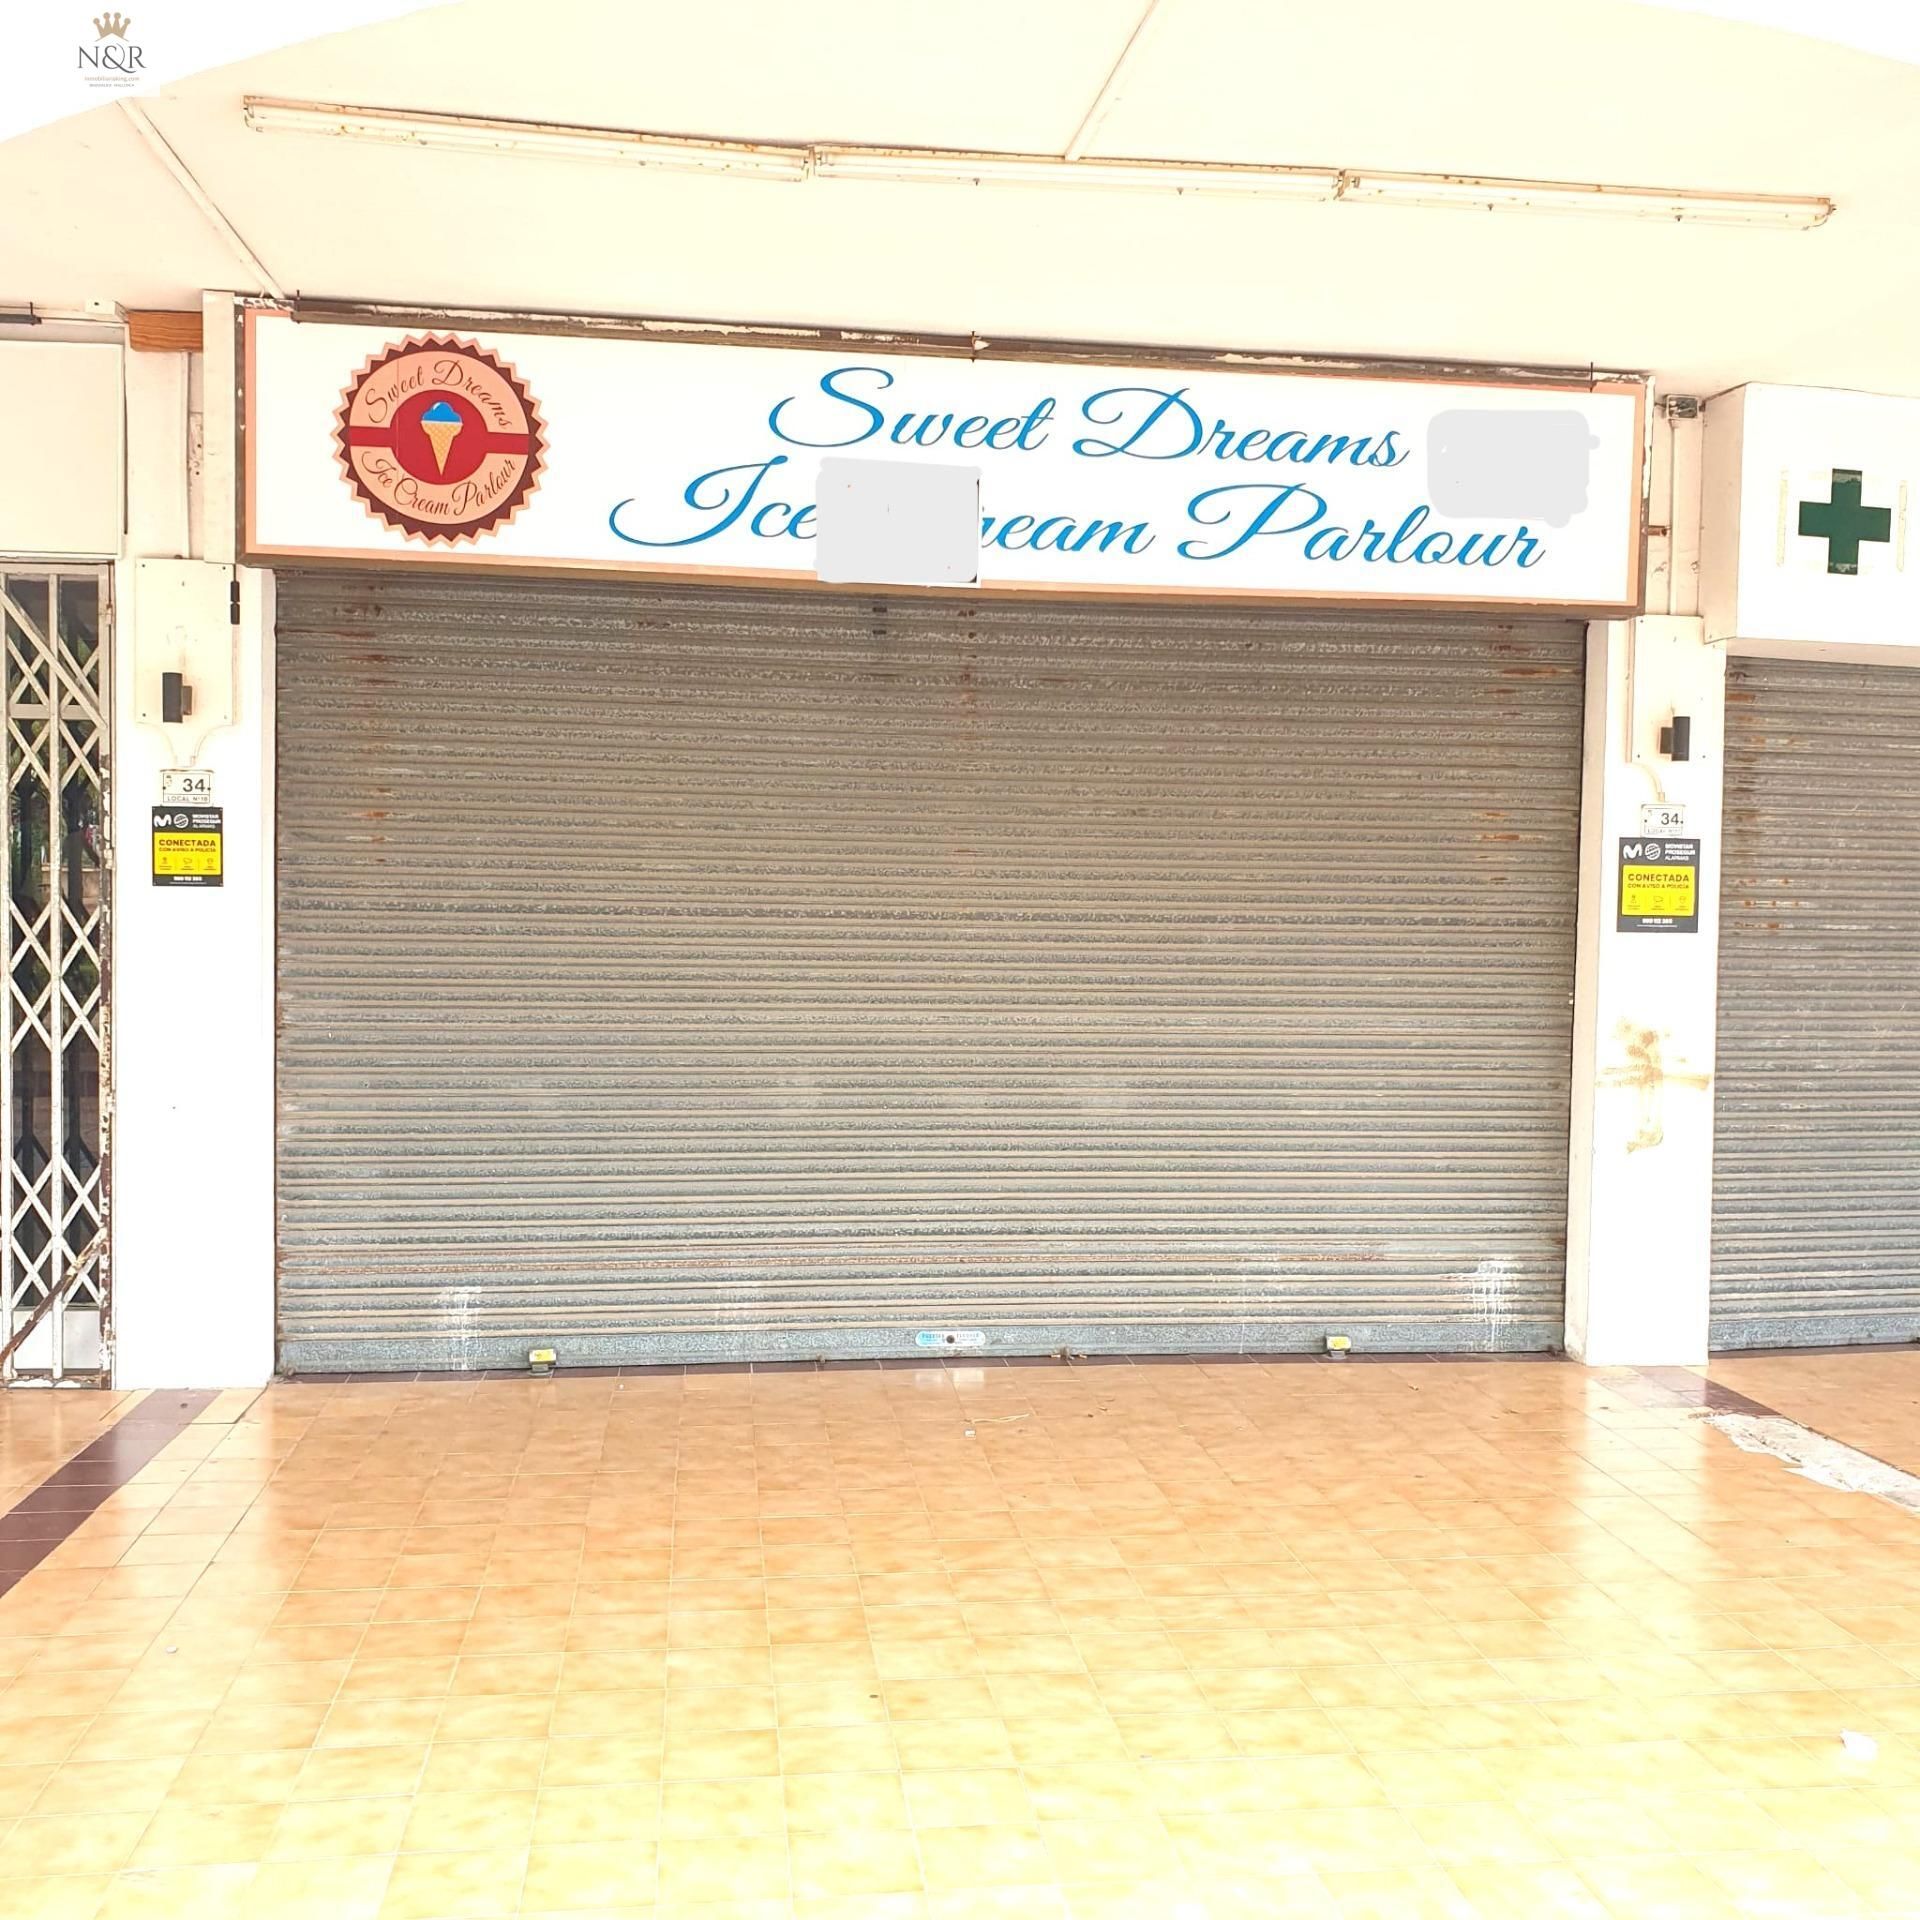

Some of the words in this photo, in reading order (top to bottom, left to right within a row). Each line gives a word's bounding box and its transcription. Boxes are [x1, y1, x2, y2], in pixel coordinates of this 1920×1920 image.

[365, 366, 424, 423] Sweet
[432, 359, 513, 429] Dreams
[768, 367, 1056, 450] Sweet
[1072, 387, 1410, 467] Dreams
[361, 451, 397, 489] Ice
[393, 472, 450, 515] Cream
[451, 458, 516, 516] Parlour
[608, 455, 817, 547] Ice
[1177, 483, 1546, 569] Parlour
[182, 778, 205, 793] 34
[1661, 812, 1679, 826] 34
[159, 839, 216, 847] CONECTADA
[1628, 873, 1690, 882] CONECTADA
